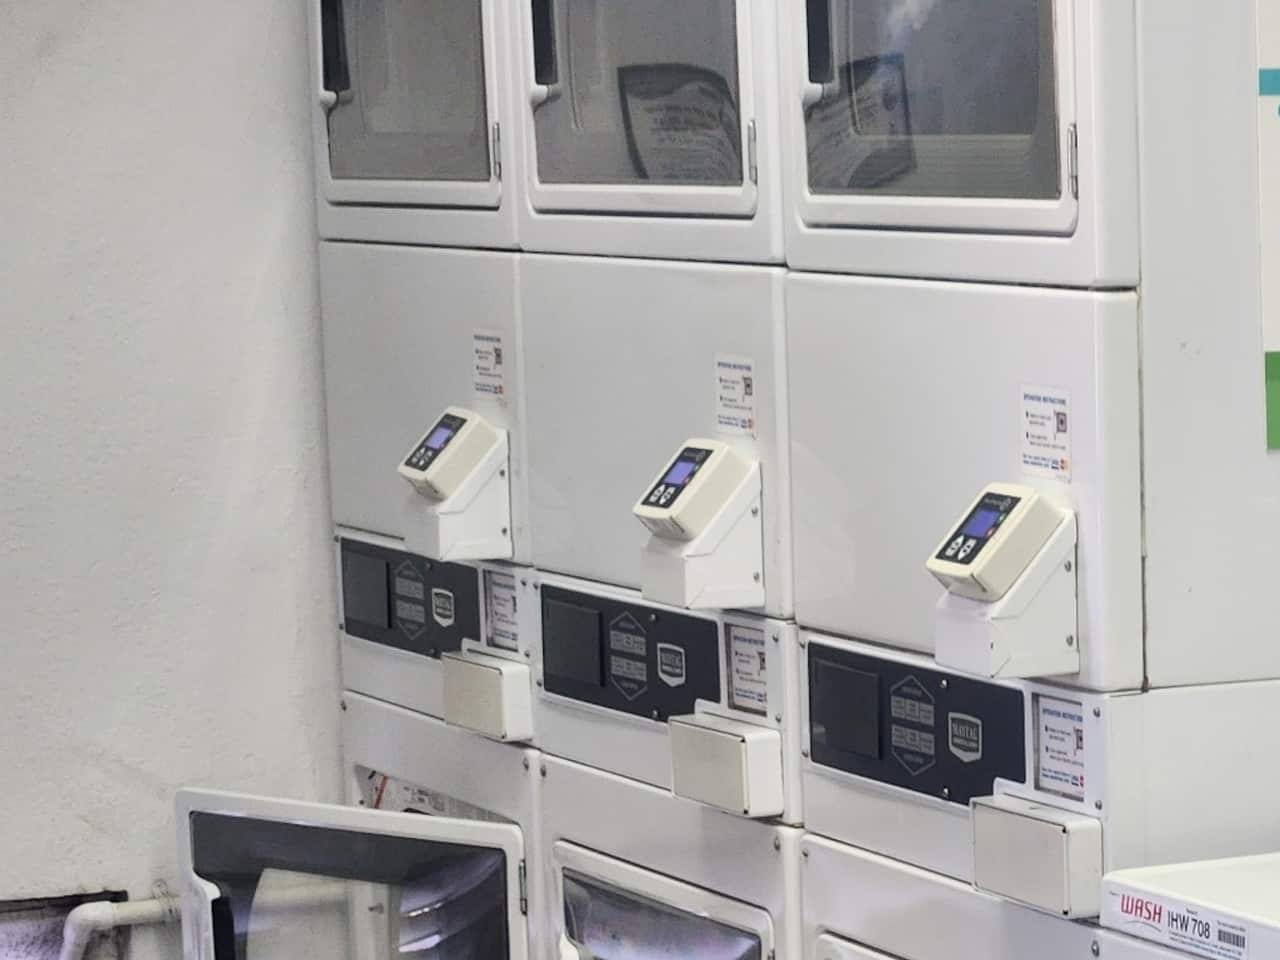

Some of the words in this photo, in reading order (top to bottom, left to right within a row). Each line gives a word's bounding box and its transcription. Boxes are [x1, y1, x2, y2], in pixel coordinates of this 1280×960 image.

[1120, 893, 1163, 923] WASH
[1167, 910, 1190, 933] IHW
[1191, 918, 1211, 939] 708
